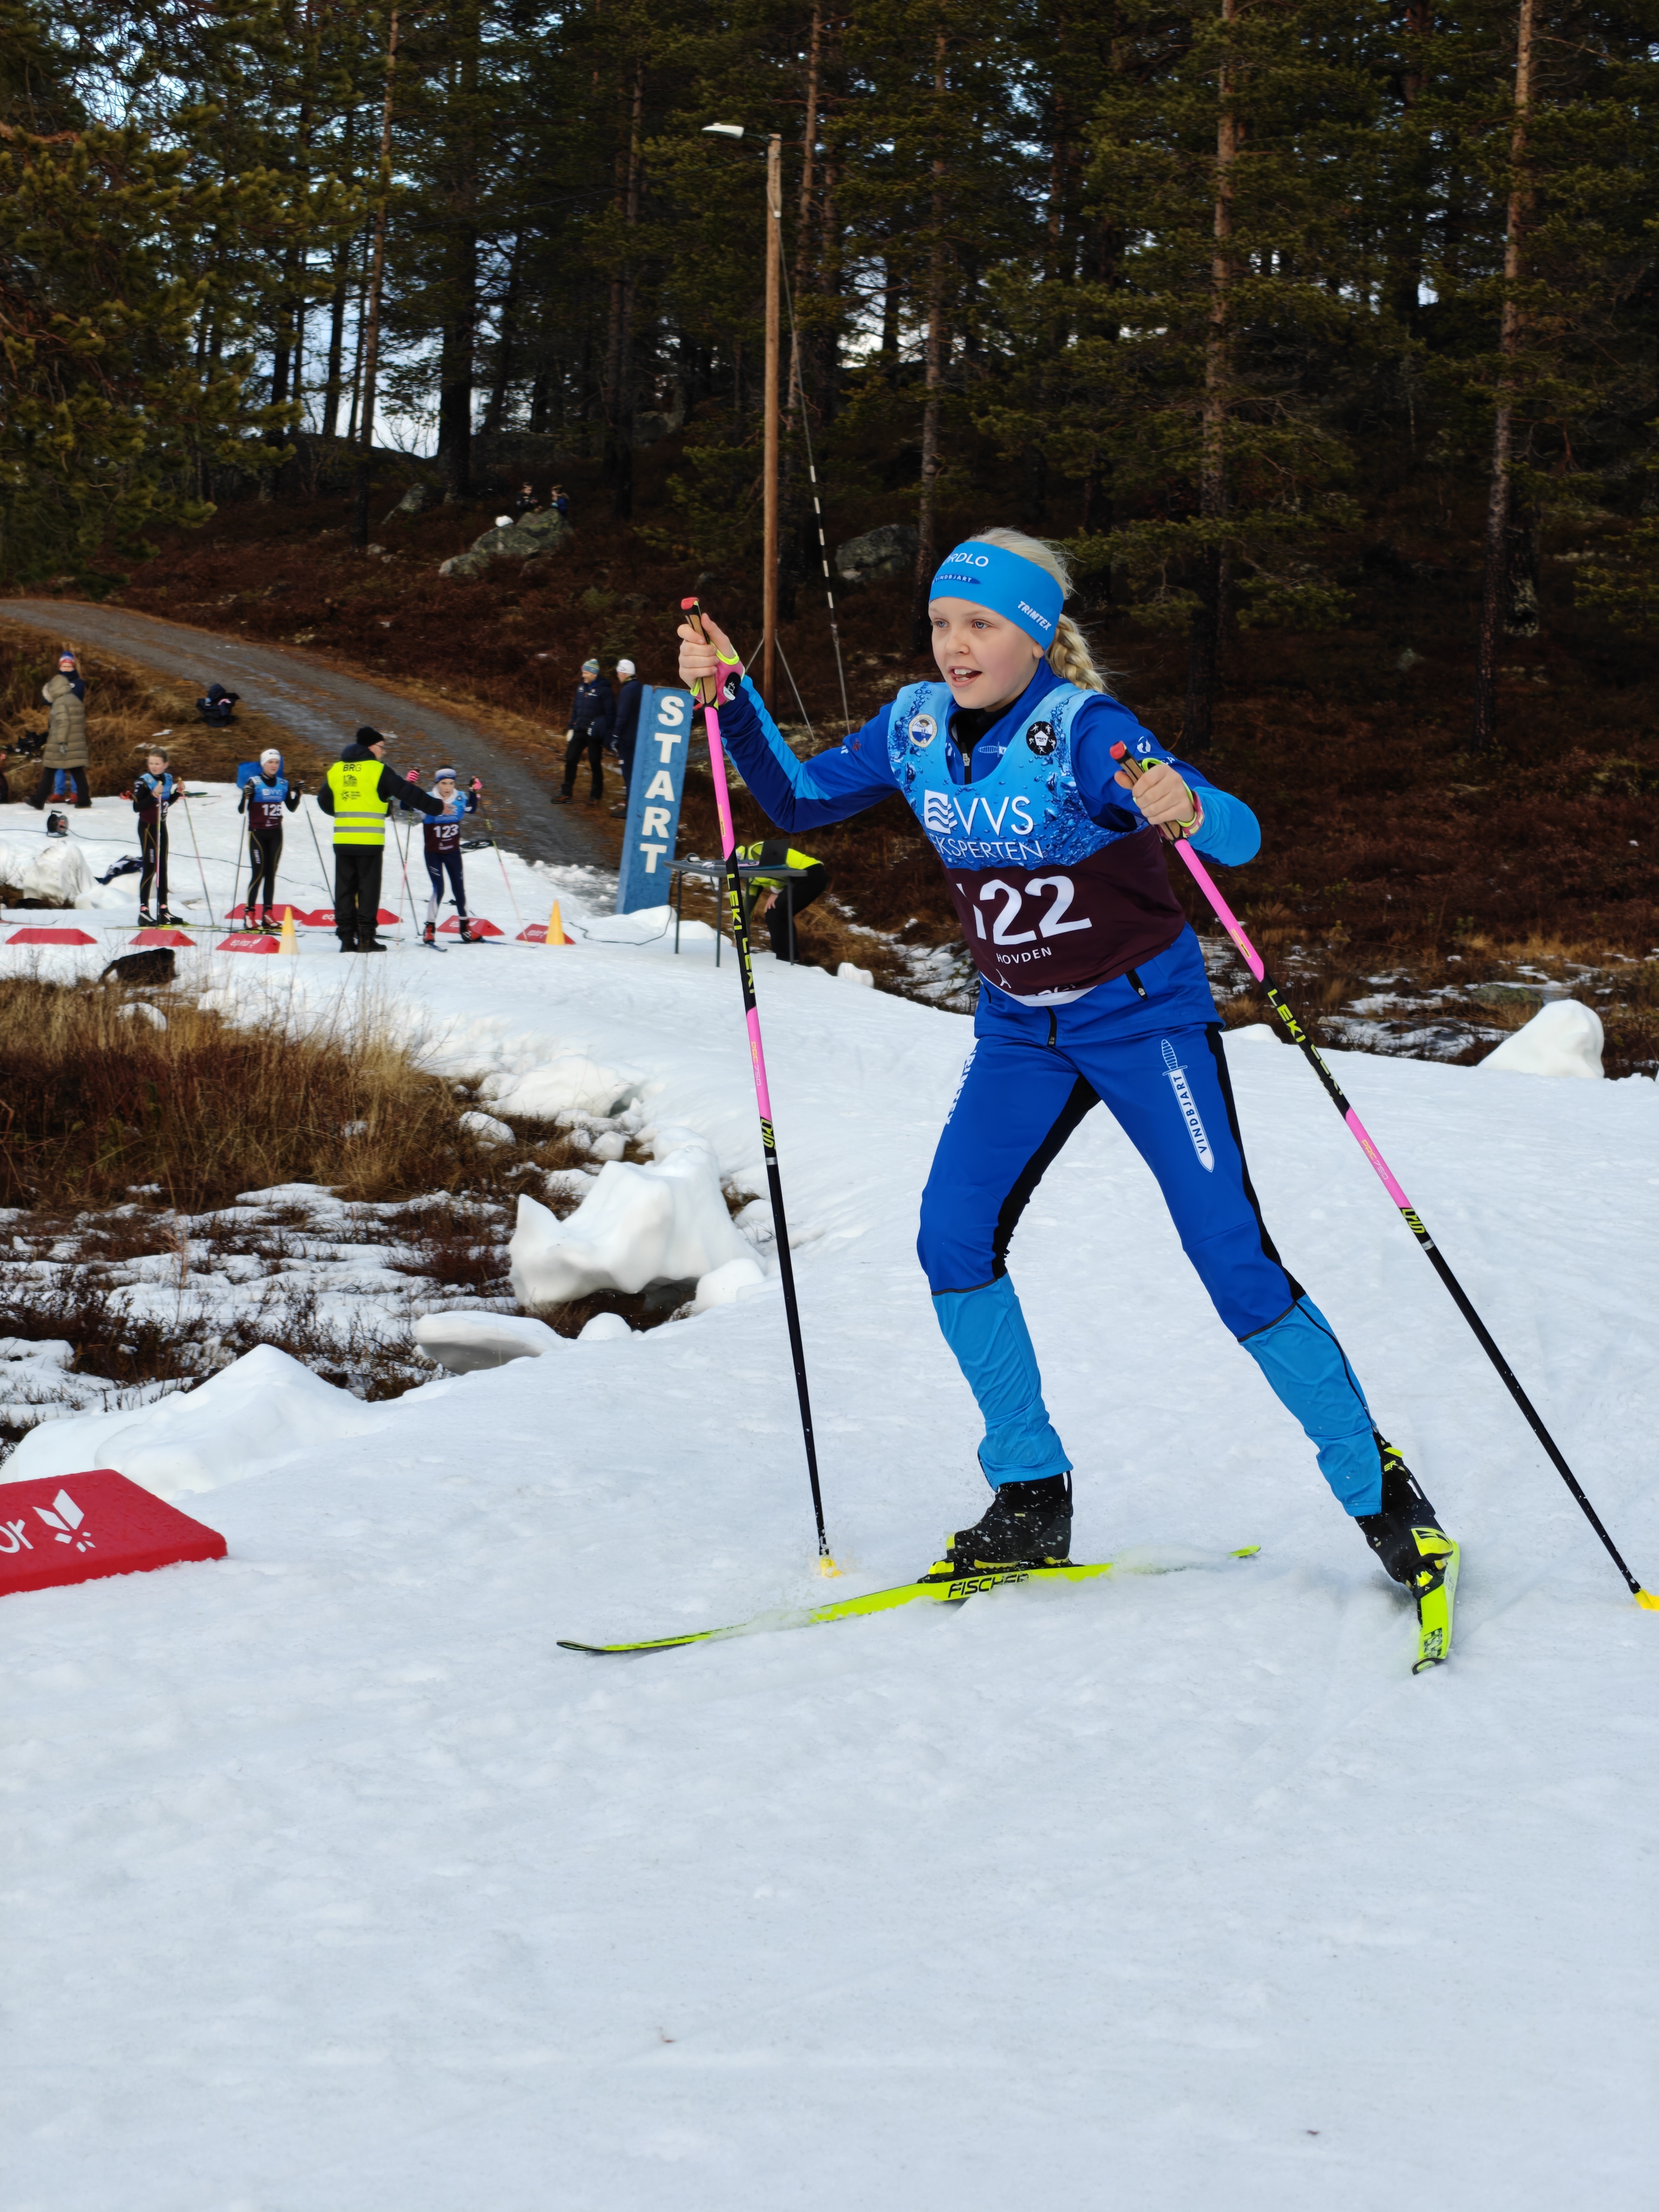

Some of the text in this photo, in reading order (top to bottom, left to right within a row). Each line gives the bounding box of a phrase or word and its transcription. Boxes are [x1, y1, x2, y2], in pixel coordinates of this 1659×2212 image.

[1017, 601, 1052, 631] TRIMTEX
[343, 764, 362, 772] BRG
[639, 696, 685, 873] START
[262, 804, 282, 817] 125
[953, 795, 1034, 837] VVS
[434, 824, 460, 838] 123
[929, 833, 1044, 860] EKSPERTEN
[726, 873, 743, 930] LEKI
[996, 946, 1053, 965] HOVDEN
[1267, 988, 1306, 1043] LEKI
[1173, 1076, 1208, 1154] VINDBJART
[1361, 1139, 1389, 1181] PRC 750
